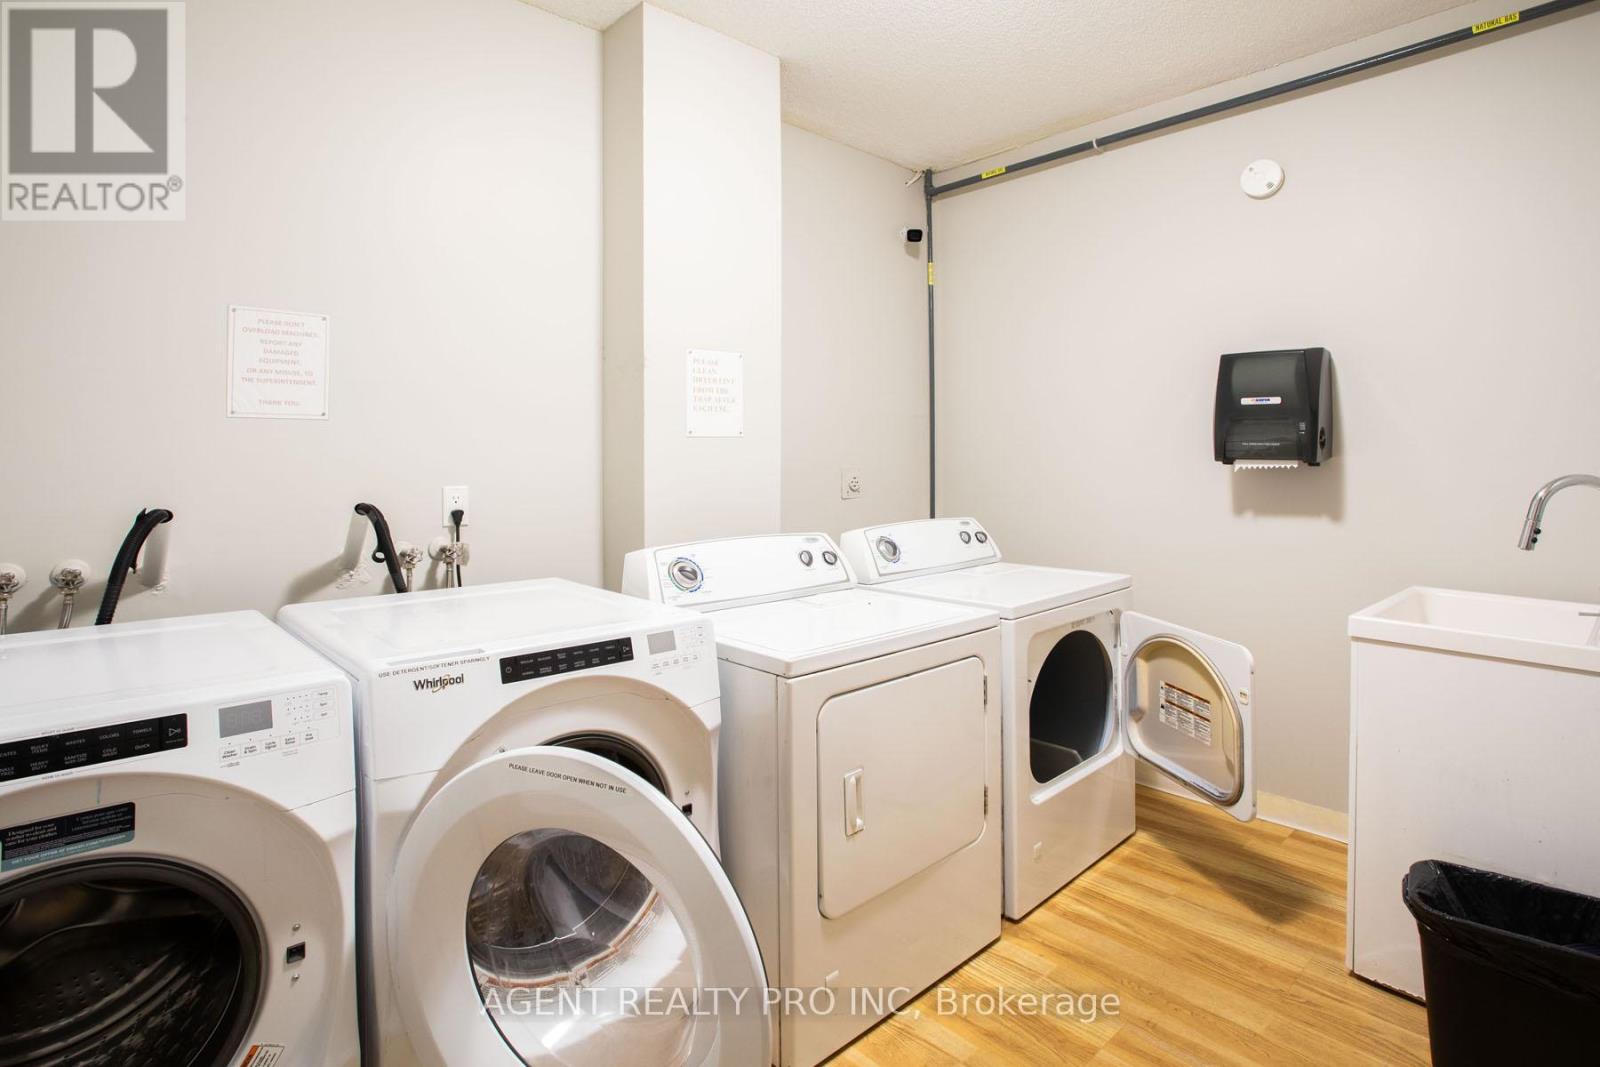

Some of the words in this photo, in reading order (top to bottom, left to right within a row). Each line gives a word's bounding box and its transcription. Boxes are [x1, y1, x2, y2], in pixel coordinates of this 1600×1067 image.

[413, 673, 464, 691] Whirlpool
[508, 763, 528, 772] PLEASE
[528, 767, 545, 776] LEAVE
[546, 771, 562, 779] DOOR
[562, 774, 578, 783] OPEN
[578, 777, 595, 786] WHEN
